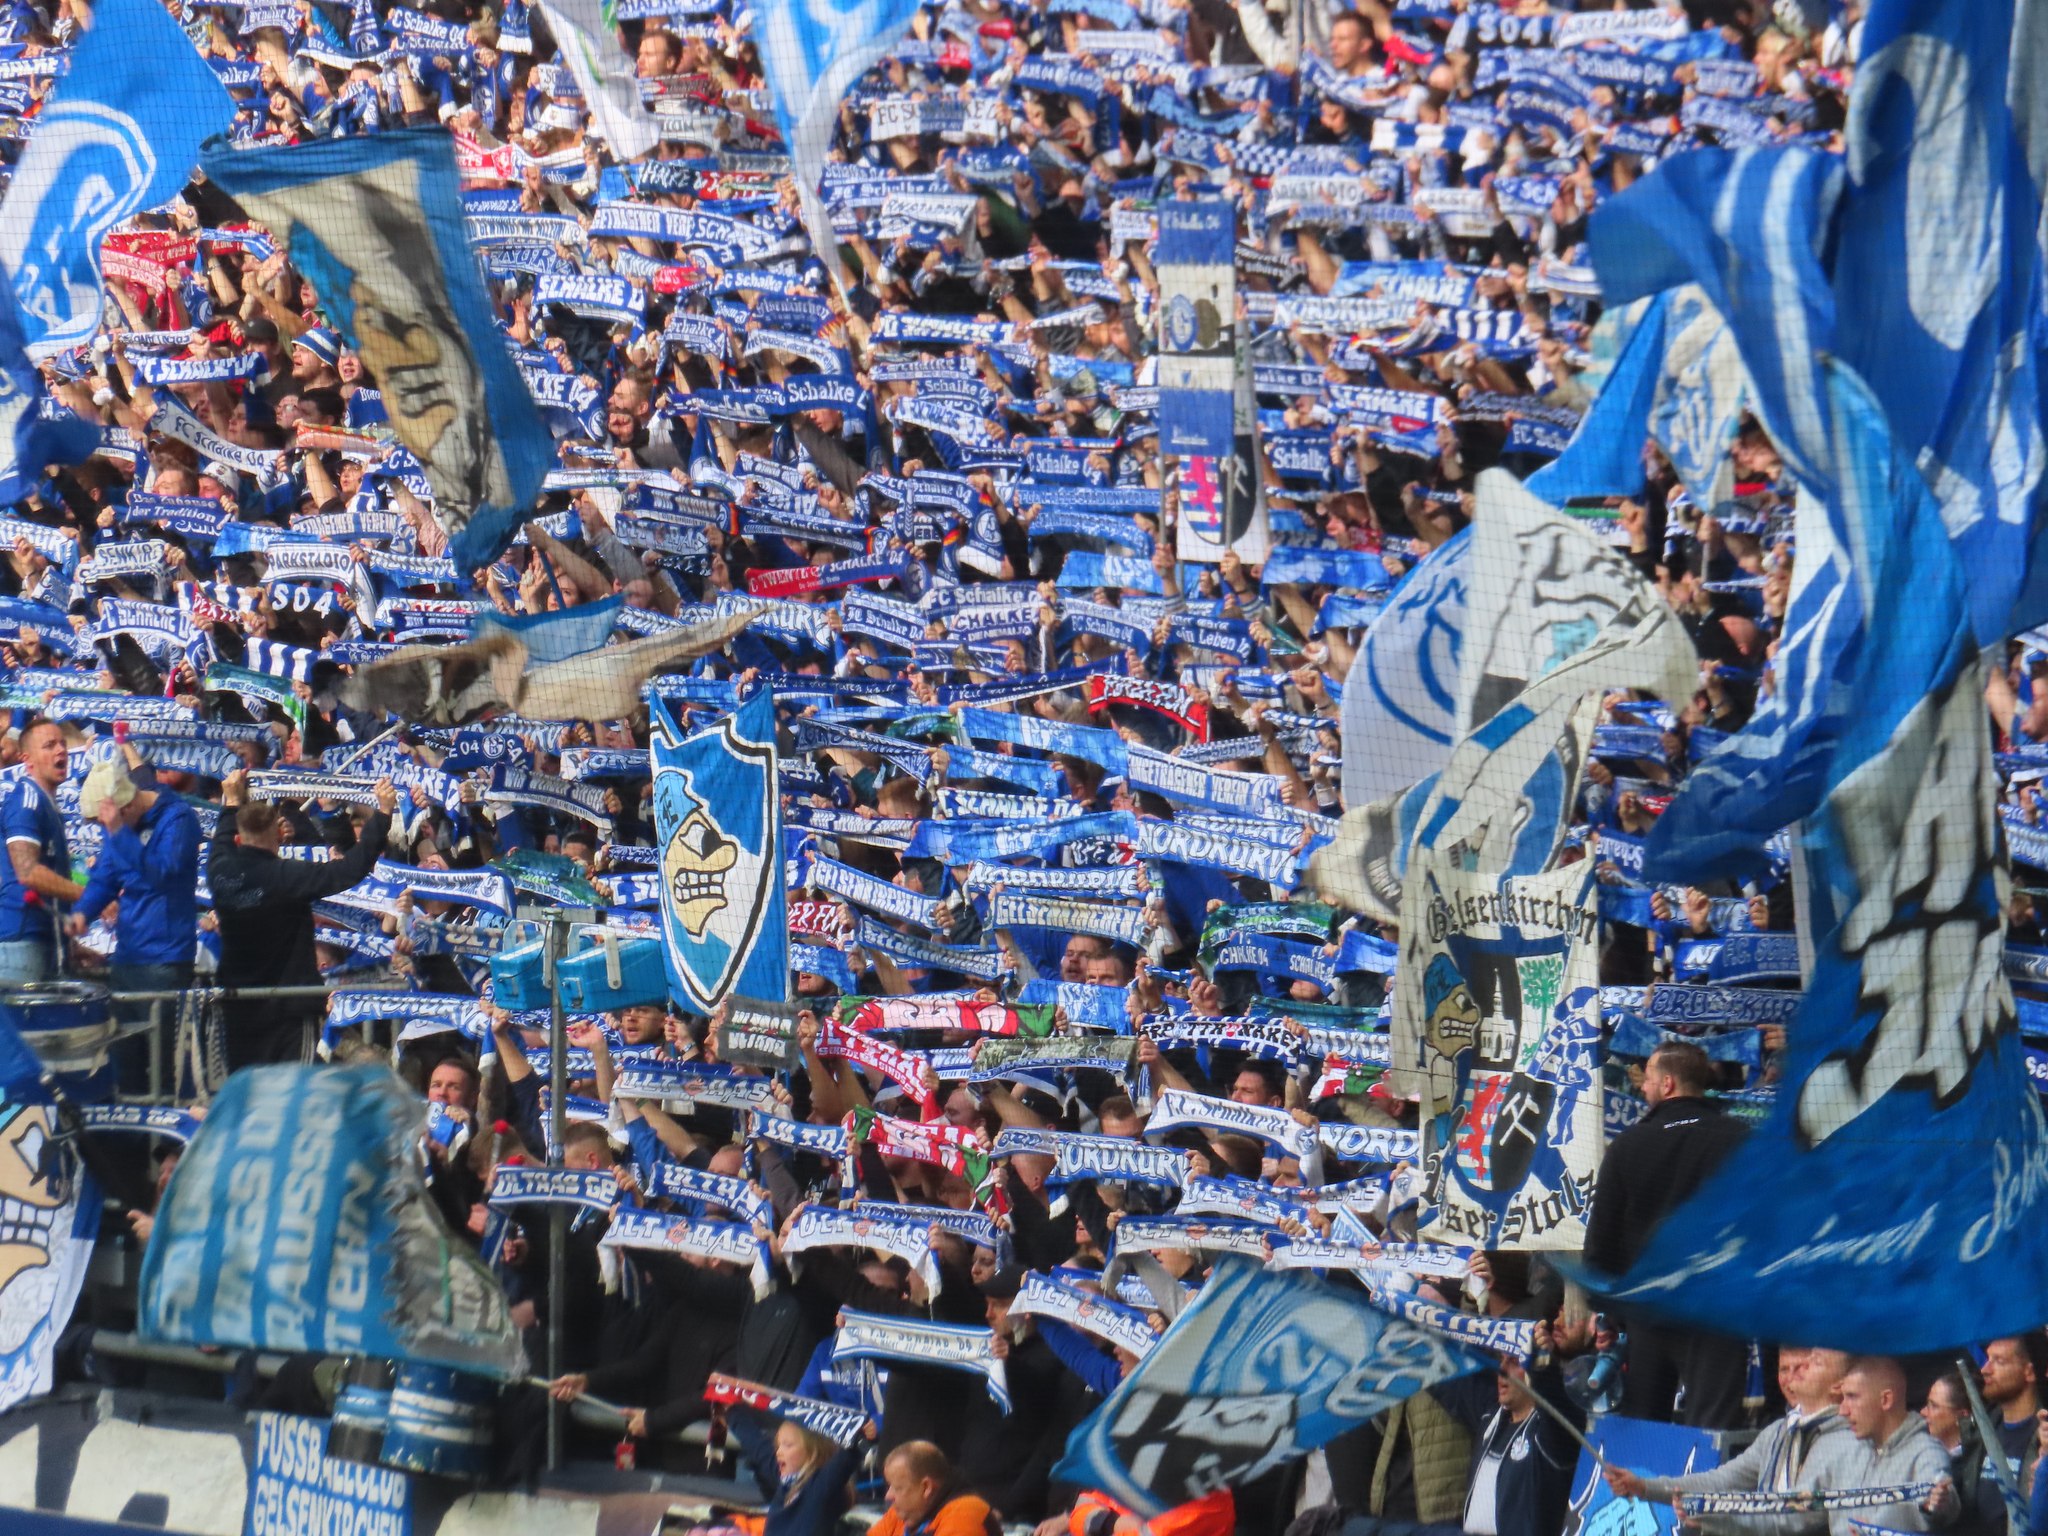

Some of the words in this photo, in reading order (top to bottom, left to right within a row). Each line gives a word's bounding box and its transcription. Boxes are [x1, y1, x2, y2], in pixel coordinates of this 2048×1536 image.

[788, 378, 855, 405] Schalke
[154, 507, 216, 522] Tradition
[272, 583, 333, 620] S04
[954, 586, 1022, 608] Schalke
[996, 895, 1138, 942] GELSENKIRCHEN
